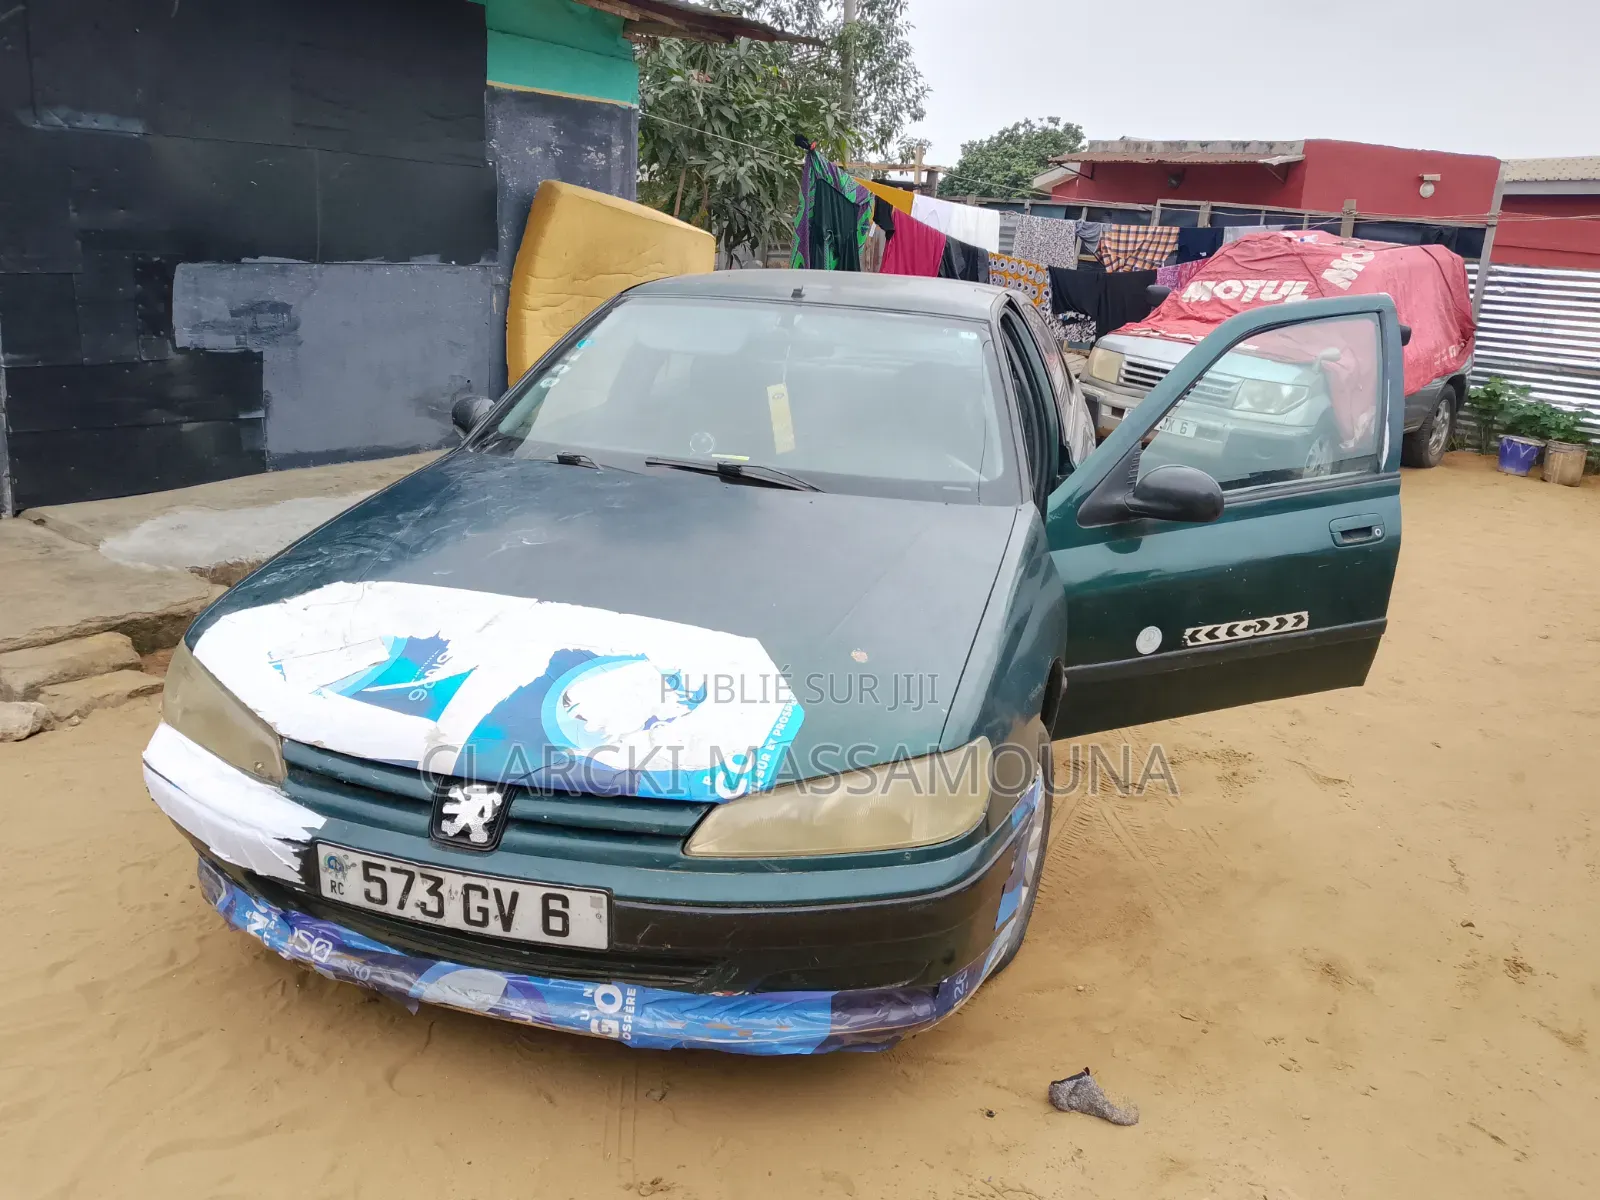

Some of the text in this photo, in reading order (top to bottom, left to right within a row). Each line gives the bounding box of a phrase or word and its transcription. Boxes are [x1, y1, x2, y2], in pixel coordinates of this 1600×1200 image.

[1181, 279, 1310, 303] MOTUL
[1179, 422, 1189, 436] 6
[330, 879, 345, 895] RC
[361, 860, 571, 938] 573 GV 6
